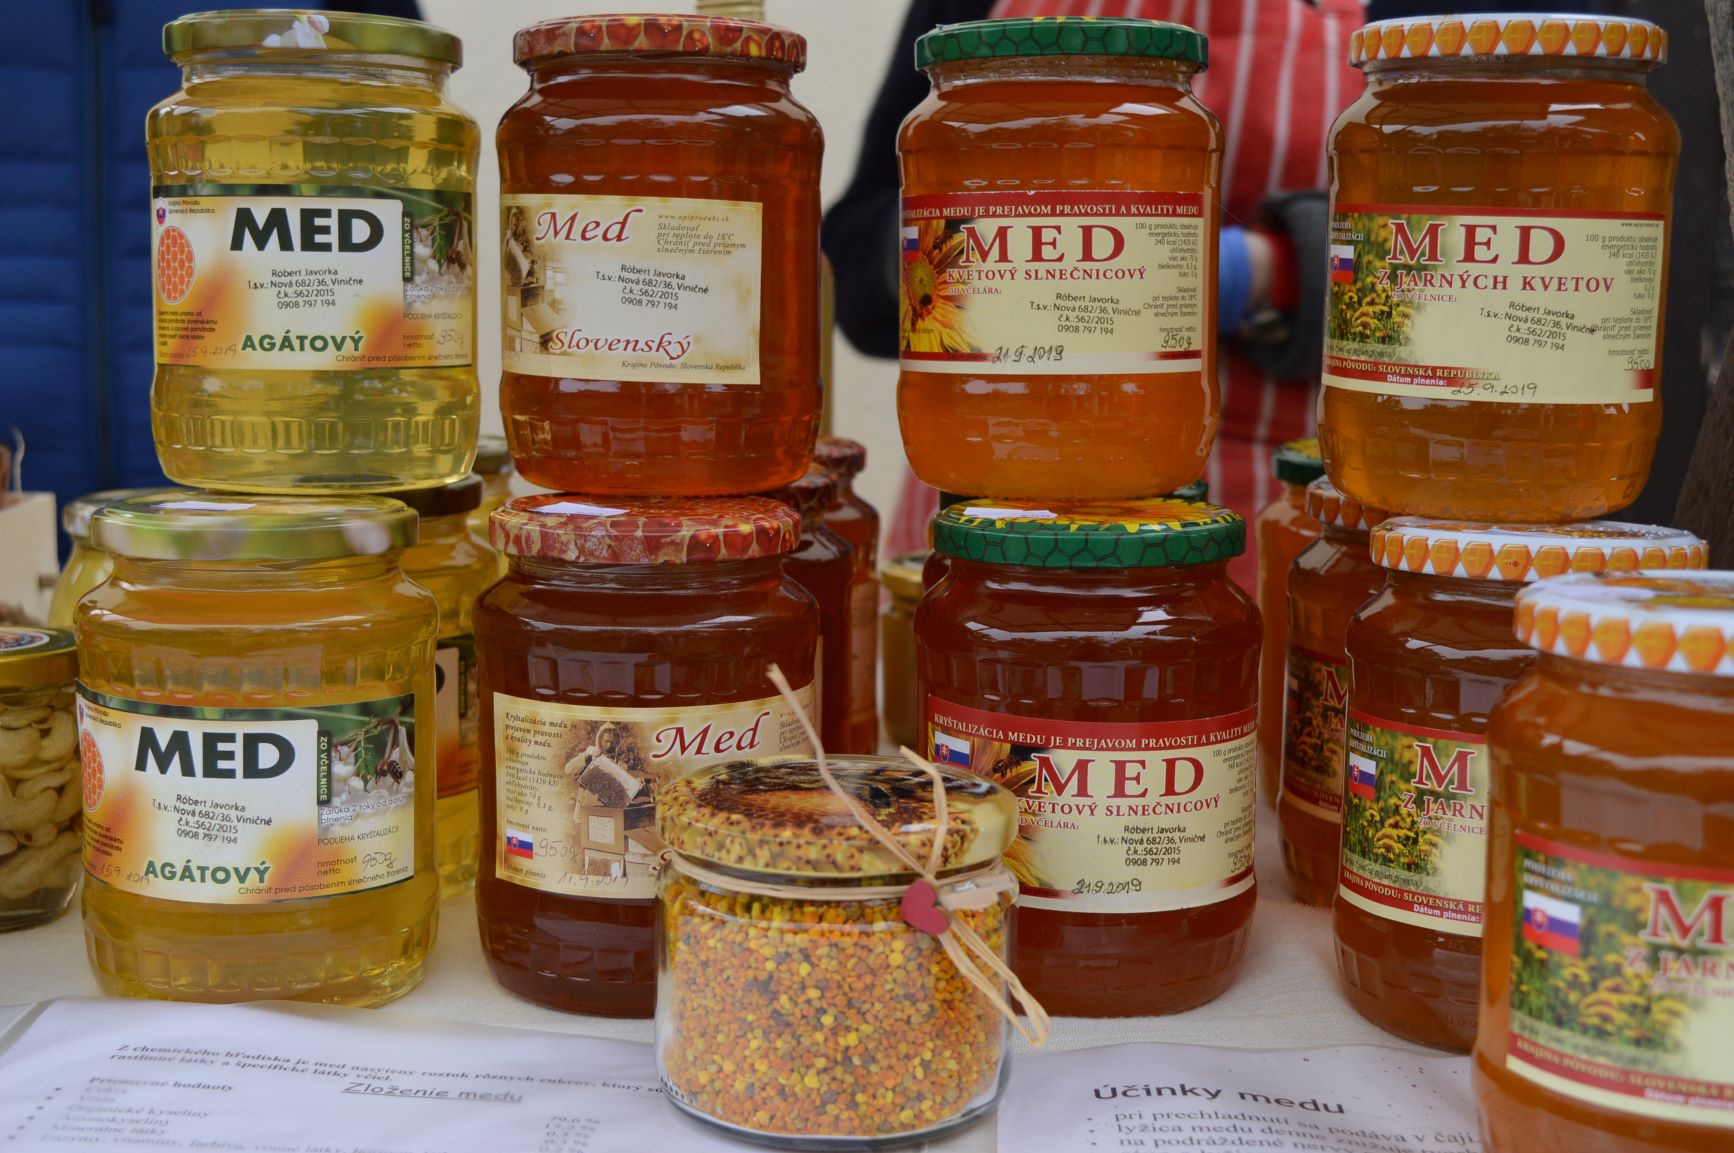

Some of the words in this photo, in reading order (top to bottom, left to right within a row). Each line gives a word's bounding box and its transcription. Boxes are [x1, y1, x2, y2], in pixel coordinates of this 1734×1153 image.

[942, 207, 971, 217] MEDU
[974, 206, 986, 218] JE
[989, 205, 1051, 216] PREJAVOM
[1056, 204, 1116, 214] PRAVOSTI
[1119, 205, 1127, 214] A
[1131, 205, 1176, 215] KVALITY
[1176, 205, 1199, 215] MEDU
[230, 207, 384, 253] MED
[535, 208, 644, 243] Med
[657, 222, 700, 232] Skladovať
[1135, 222, 1146, 230] 100
[656, 231, 670, 240] pri
[672, 231, 702, 242] teplote
[703, 232, 714, 241] do
[692, 239, 711, 249] pred
[1385, 221, 1566, 265] MED
[1585, 234, 1599, 242] 100
[1608, 234, 1637, 243] produktu
[961, 225, 1125, 264] MED
[305, 267, 339, 277] Javorka
[653, 269, 686, 281] Javorka
[947, 267, 1017, 281] KVETOVÝ
[1024, 266, 1146, 281] SLNEČNICOVÝ
[270, 279, 294, 289] Nová
[295, 277, 329, 288] 682/36,
[617, 275, 641, 286] Nová
[642, 279, 675, 291] 682/36,
[1378, 270, 1390, 286] Z
[1396, 270, 1509, 291] JARNÝCH
[1520, 275, 1616, 293] KVETOV
[277, 300, 301, 309] 0908
[303, 299, 318, 308] 797
[321, 299, 336, 307] 194
[621, 296, 643, 307] 0908
[645, 299, 660, 309] 797
[663, 301, 678, 311] 194
[1087, 295, 1120, 305] Javorka
[1404, 292, 1457, 303] VČELNICE:
[1053, 303, 1077, 313] Nová
[1077, 305, 1110, 316] 682/36,
[1542, 308, 1575, 320] Javorka
[1504, 312, 1529, 324] Nová
[1530, 317, 1564, 330] 682/36,
[1057, 325, 1080, 334] 0908
[1081, 325, 1097, 335] 797
[1099, 326, 1114, 336] 194
[241, 329, 365, 353] AGÁTOVÝ
[550, 329, 692, 361] Slovenský
[1161, 333, 1192, 351] 950g
[1506, 335, 1530, 346] 0908
[1531, 339, 1548, 349] 797
[1550, 341, 1565, 351] 194
[367, 354, 388, 364] pred
[1342, 360, 1377, 372] PÔVODU:
[1378, 364, 1433, 377] SLOVENSKÁ
[1436, 368, 1501, 381] REPUBLIKA
[1387, 374, 1412, 385] Dátum
[1413, 377, 1447, 387] plnenia:
[652, 711, 771, 759] Med
[934, 713, 1005, 740] KRYŠTALIZÁCIA
[1007, 731, 1046, 745] MEDU
[1048, 736, 1064, 748] JE
[1067, 737, 1136, 750] PREJAVOM
[1141, 735, 1198, 749] PRAVOSTI
[1200, 734, 1207, 744] A
[1209, 728, 1243, 743] KVALITY
[320, 736, 328, 750] ZO
[135, 726, 296, 779] MED
[320, 752, 329, 801] VČELNICE
[1030, 755, 1205, 799] MED
[210, 800, 246, 813] Javorka
[1105, 794, 1221, 817] SLNEČNICOVÝ
[1403, 793, 1415, 810] Z
[1423, 796, 1487, 821] JARN
[198, 810, 234, 824] 682/36,
[320, 814, 353, 825] plnenia
[1030, 816, 1080, 830] VČELÁRA:
[176, 828, 200, 840] 0908
[202, 832, 219, 843] 797
[221, 834, 238, 845] 194
[1156, 824, 1187, 834] Javorka
[317, 835, 355, 847] PODLIEHA
[1120, 835, 1144, 845] Nová
[1145, 835, 1178, 846] 682/36,
[1125, 857, 1148, 867] 0908
[1149, 857, 1165, 866] 797
[1167, 857, 1181, 866] 194
[143, 858, 271, 885] AGÁTOVÝ
[239, 886, 272, 895] Chrániť
[274, 884, 297, 896] pred
[298, 881, 346, 894] pôsobením
[1364, 880, 1401, 899] PÔVODU:
[1403, 892, 1465, 912] SLOVENSKÁ
[1413, 904, 1441, 917] Dátum
[1442, 908, 1480, 923] plnenia:
[117, 1043, 130, 1051] Z
[132, 1045, 221, 1058] chemického
[224, 1050, 291, 1064] hľadiska
[294, 1058, 310, 1066] je
[313, 1060, 347, 1069] med
[601, 1080, 643, 1091] ktorý
[172, 1080, 236, 1092] hodnoty
[342, 1081, 449, 1098] Zloženie
[457, 1090, 523, 1104] medu
[1093, 1083, 1223, 1100] Účinky
[1238, 1089, 1345, 1115] medu
[1114, 1110, 1143, 1122] pri
[1151, 1109, 1290, 1126] prechladnutí
[1297, 1120, 1321, 1130] sa
[1327, 1126, 1408, 1143] podáva
[1412, 1134, 1426, 1143] v
[1117, 1123, 1185, 1135] lyžica
[1191, 1124, 1252, 1134] medu
[1260, 1126, 1327, 1142] denne
[1119, 1137, 1145, 1147] na
[1152, 1135, 1286, 1150] podráždené
